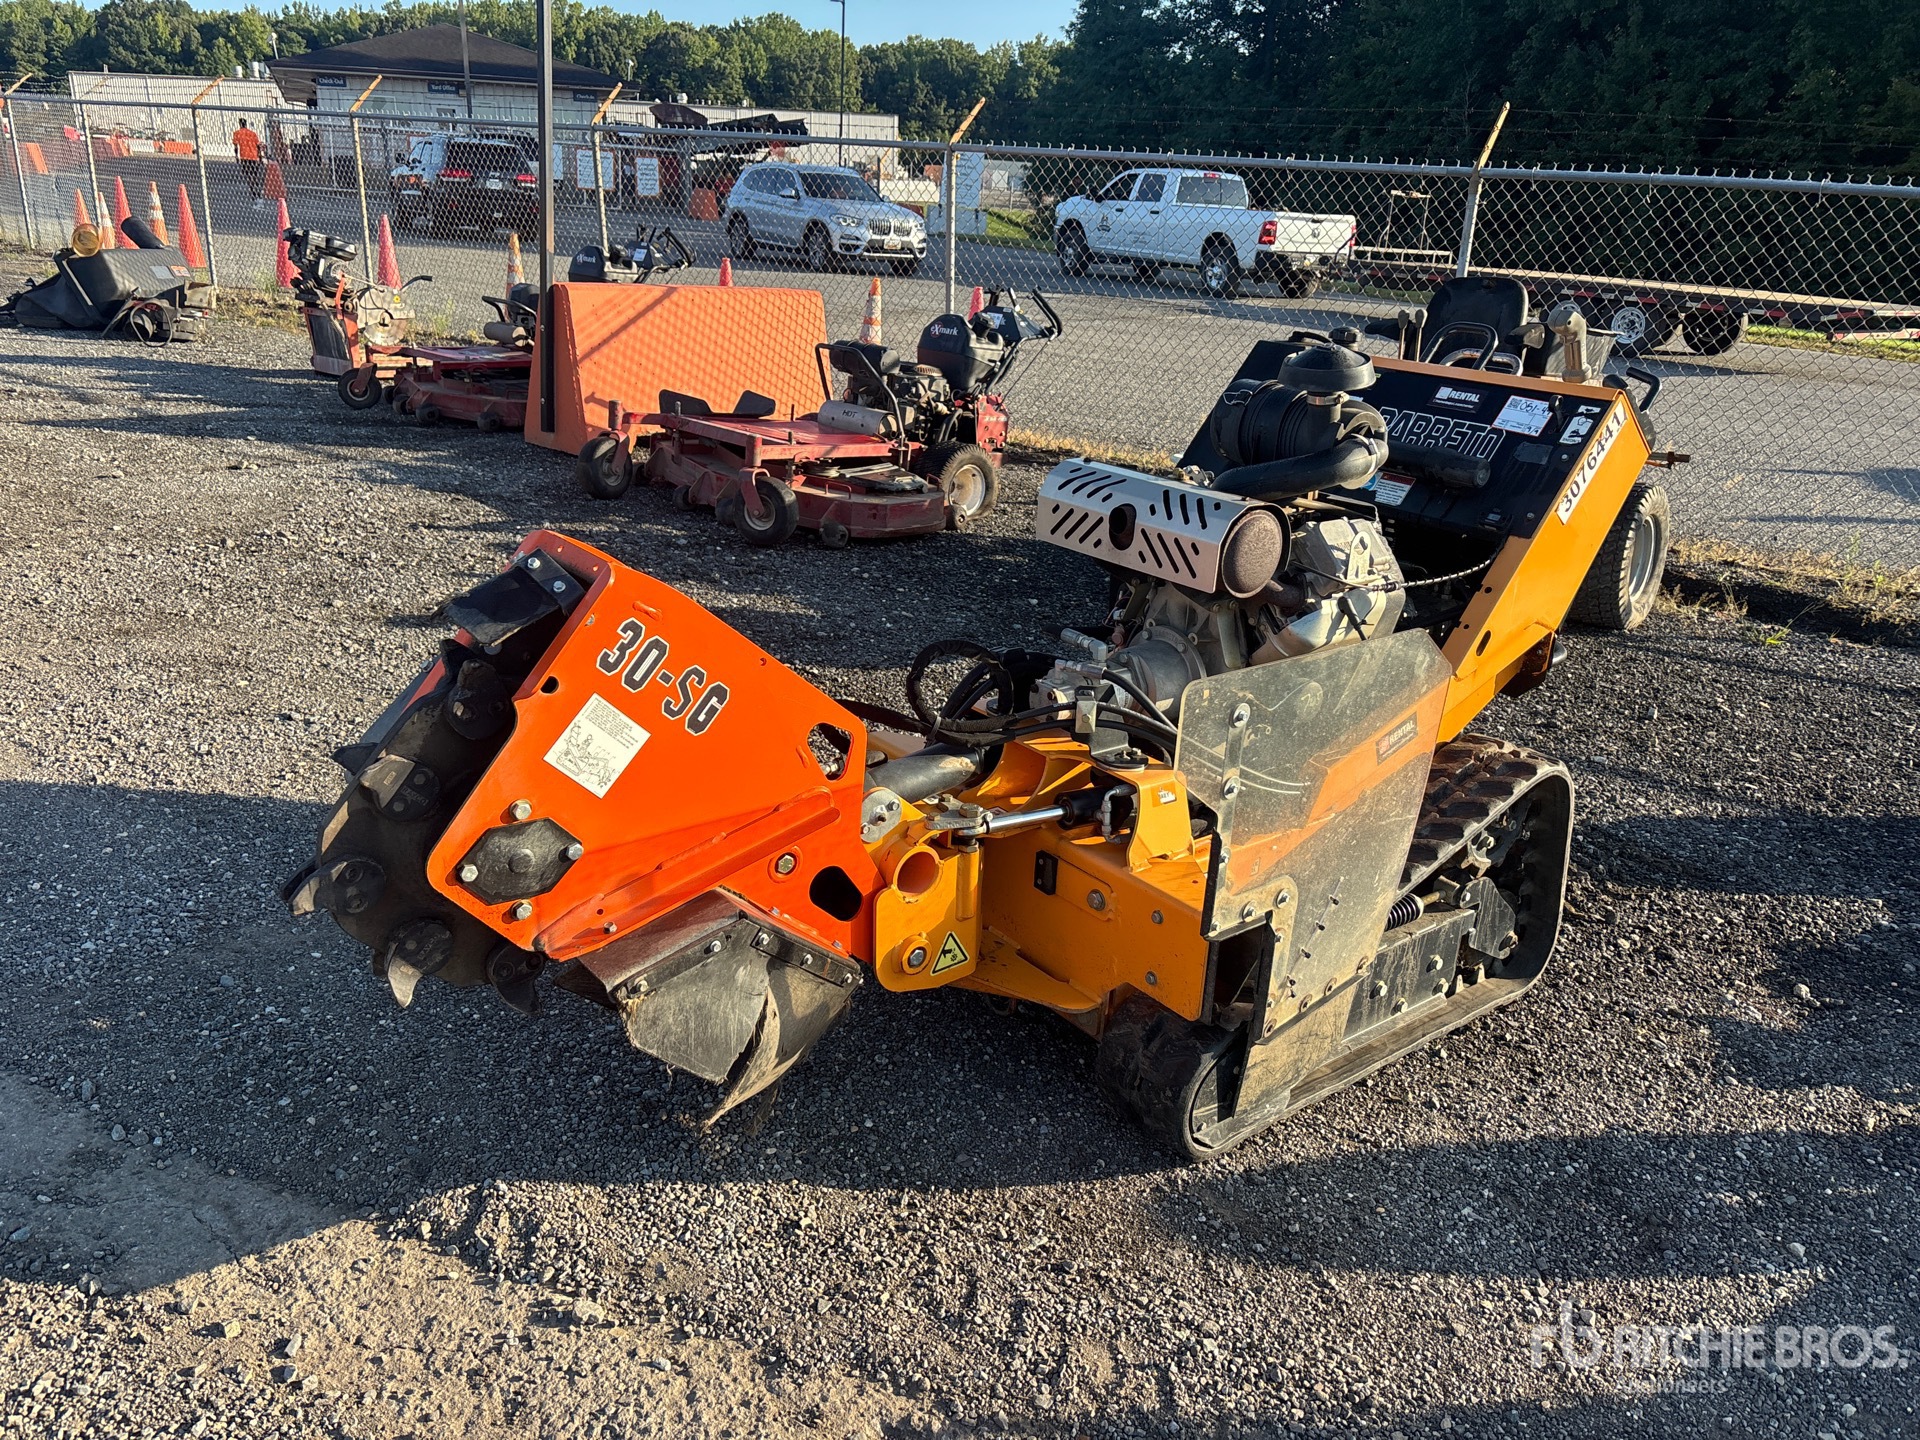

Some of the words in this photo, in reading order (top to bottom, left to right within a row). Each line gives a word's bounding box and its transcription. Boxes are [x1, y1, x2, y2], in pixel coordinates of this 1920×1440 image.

[1449, 390, 1480, 403] RENTAL
[842, 409, 859, 419] HOT
[1563, 411, 1622, 513] 3076441
[596, 617, 730, 736] 30-SG
[1389, 720, 1415, 746] RENTAL
